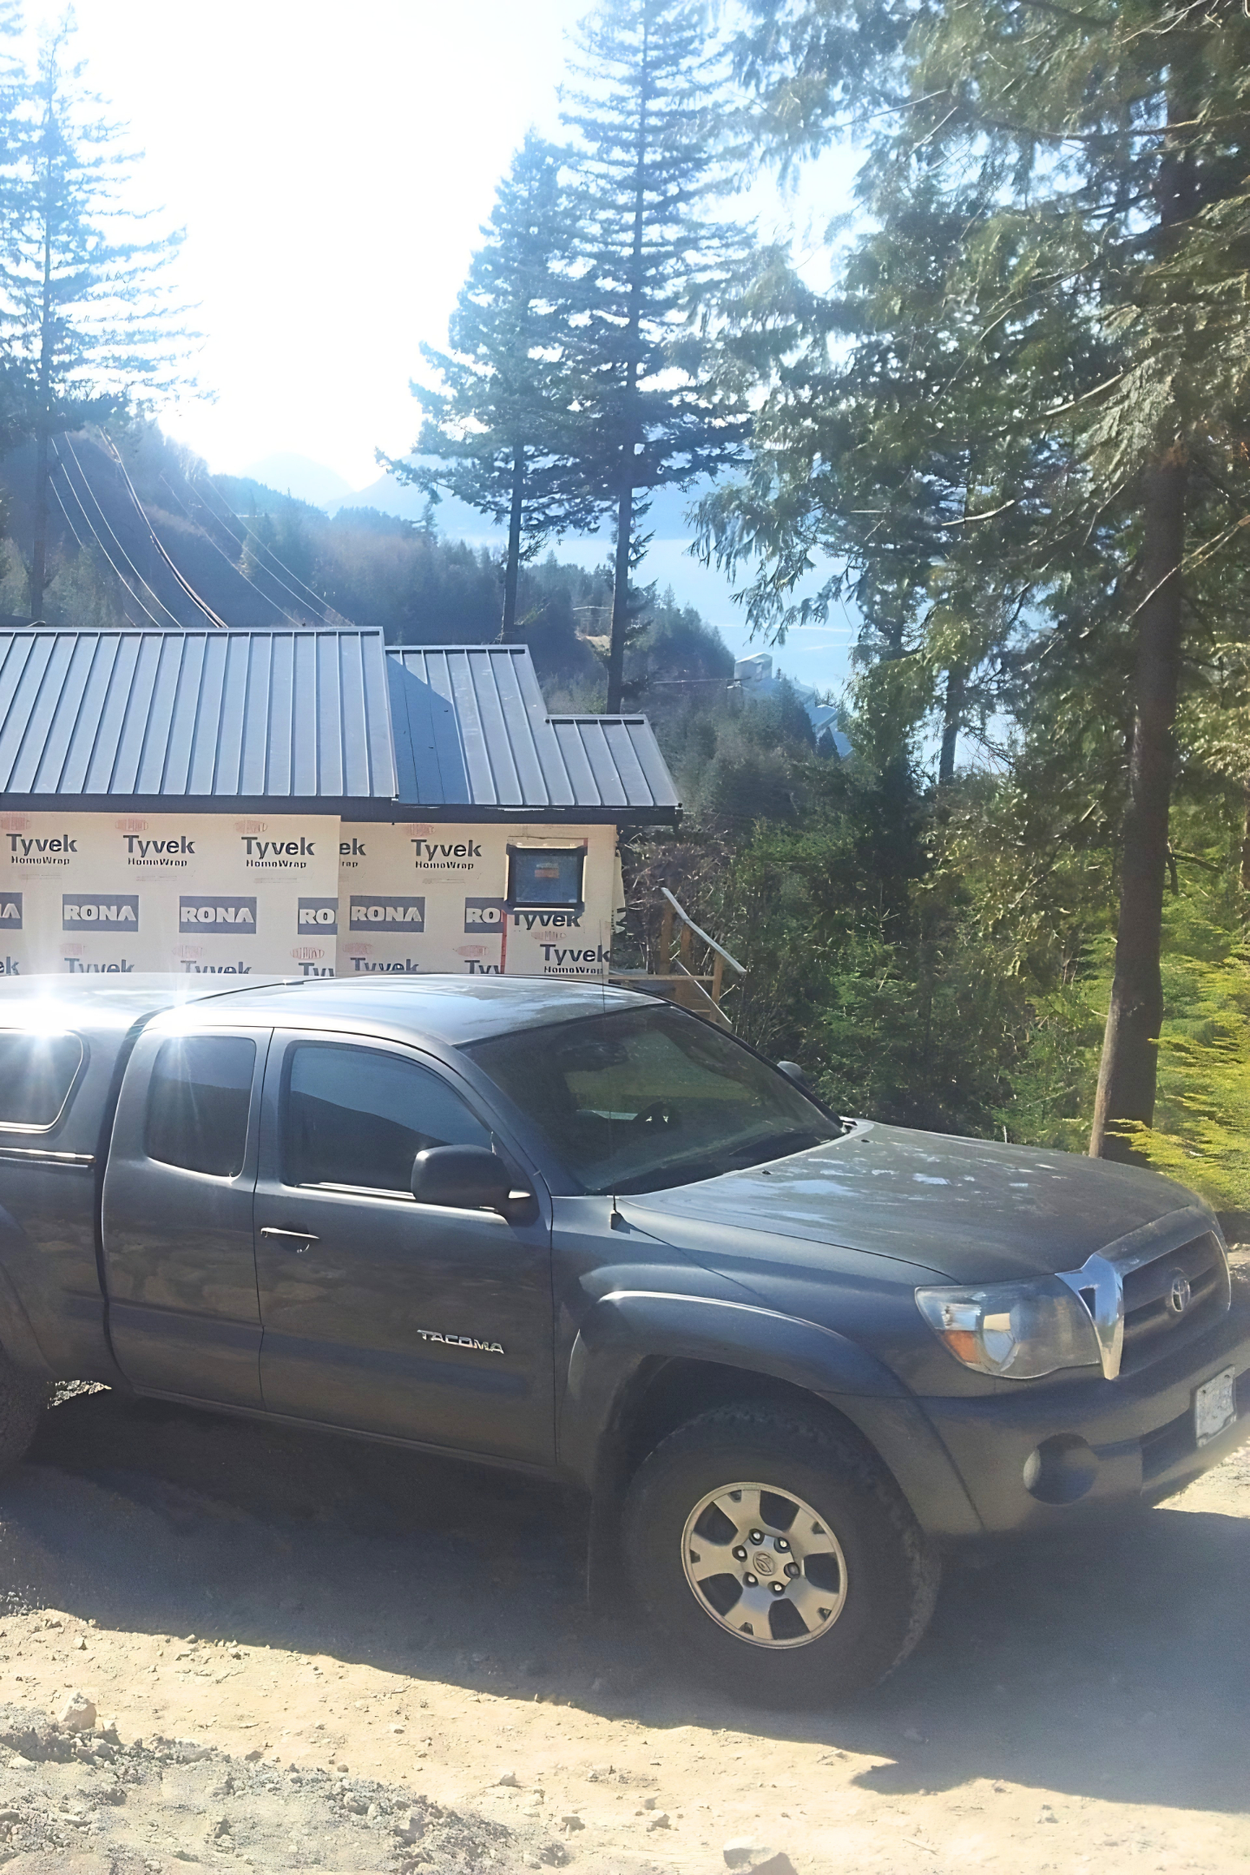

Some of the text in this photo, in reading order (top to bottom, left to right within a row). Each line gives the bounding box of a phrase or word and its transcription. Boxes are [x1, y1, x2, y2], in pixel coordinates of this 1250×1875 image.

[6, 833, 78, 856] Tyvek
[123, 835, 196, 858] Tyvek
[241, 837, 316, 859] Tyvek
[411, 839, 482, 861] Tyvek
[11, 856, 71, 866] HomeWrap
[127, 857, 188, 867] HomeWrap
[245, 859, 307, 869] HomeWrap
[415, 861, 475, 870] HomeWrap
[64, 904, 138, 922] RONA
[180, 906, 255, 924] RONA
[350, 906, 423, 923] RONA
[539, 943, 610, 966] Tyvek
[417, 1329, 505, 1355] TACOMA
